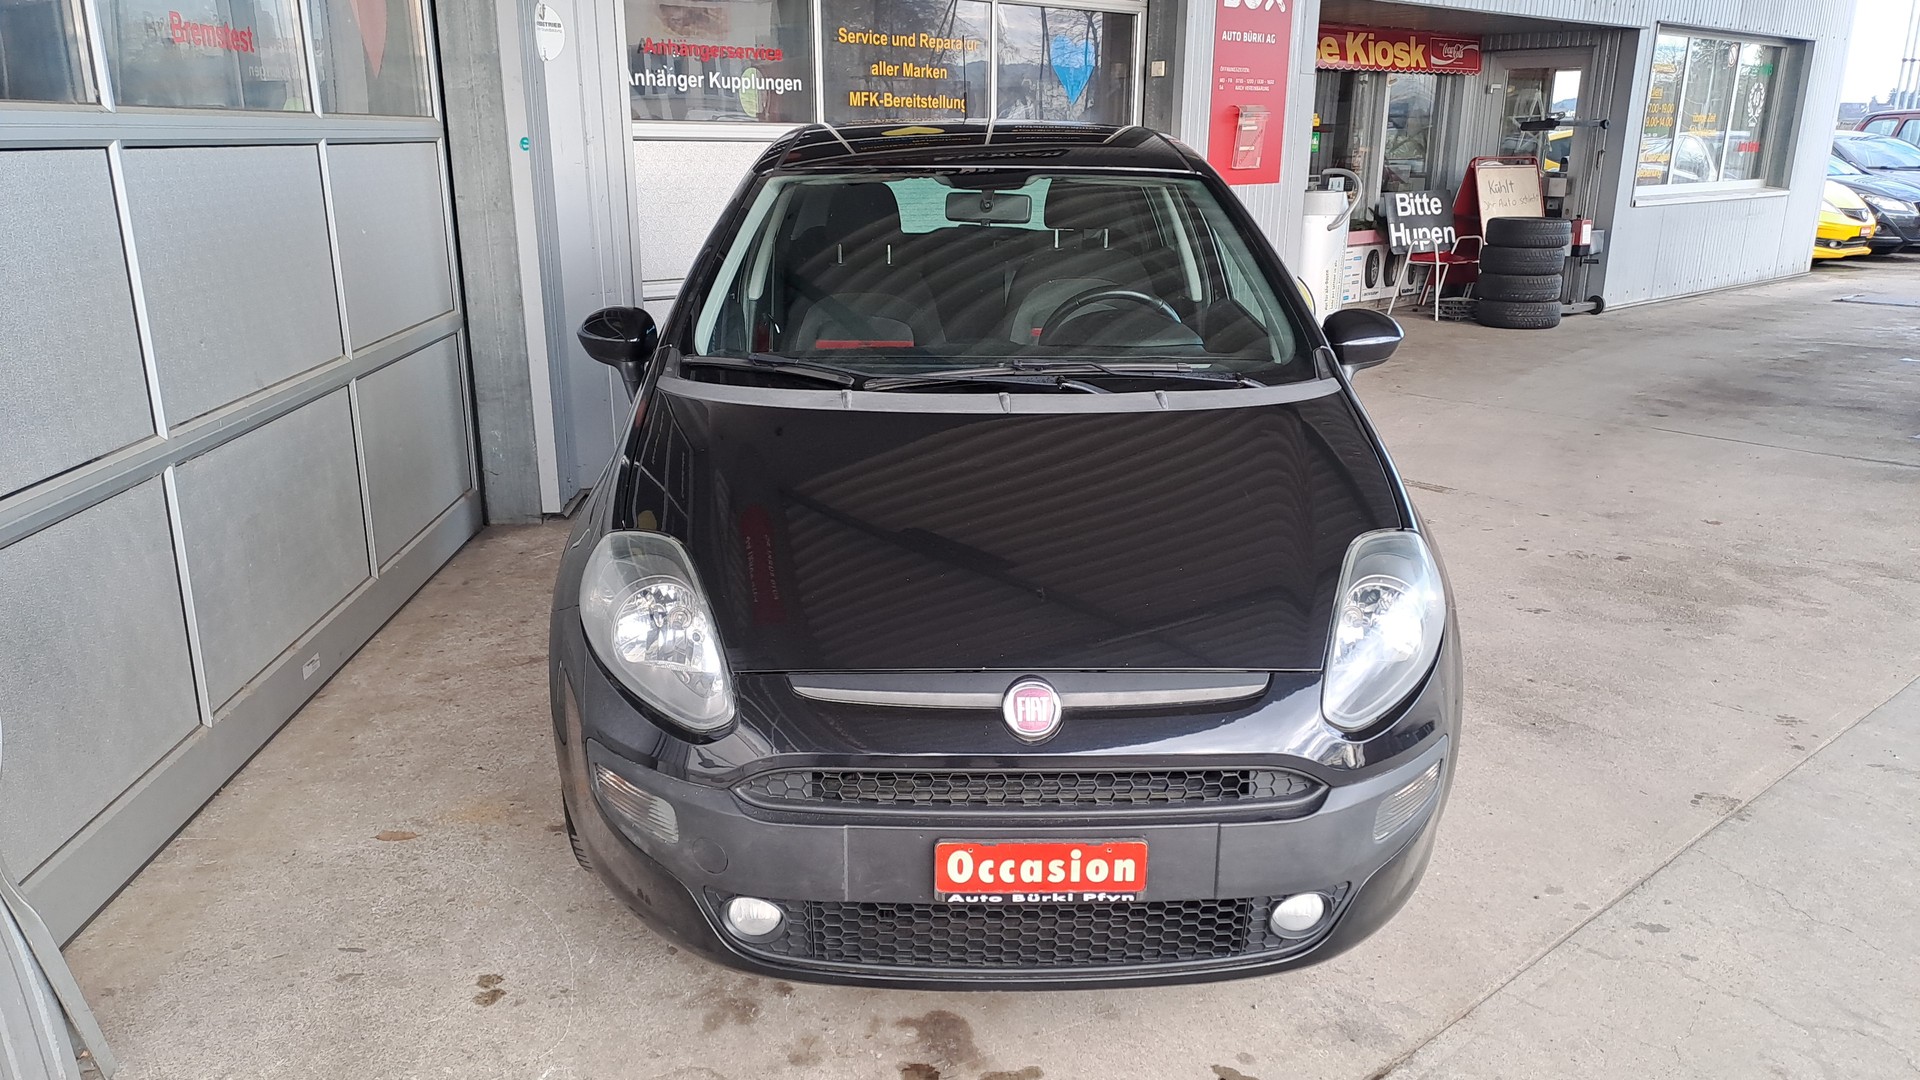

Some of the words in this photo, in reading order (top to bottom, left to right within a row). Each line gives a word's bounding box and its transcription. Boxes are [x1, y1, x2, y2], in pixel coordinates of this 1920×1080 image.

[169, 11, 254, 53] Bremstest
[838, 27, 888, 46] Service
[892, 33, 916, 47] und
[1222, 30, 1241, 41] AUTO
[1243, 30, 1264, 43] BÜRKI
[1266, 34, 1276, 44] AG
[643, 37, 784, 62] Anhängerservice
[1346, 31, 1427, 68] Kiosk
[871, 61, 899, 76] aller
[903, 62, 948, 79] Marken
[709, 72, 802, 94] Kupplungen
[1488, 179, 1514, 194] Kühlt
[1395, 193, 1442, 217] Bitte
[1499, 198, 1517, 207] Auto
[1389, 223, 1456, 251] Hupen
[1016, 696, 1050, 723] FIAT
[947, 849, 1136, 884] Occasion
[947, 893, 1002, 903] Auto
[1012, 892, 1074, 903] Bürki
[1083, 893, 1136, 903] Pfyn
